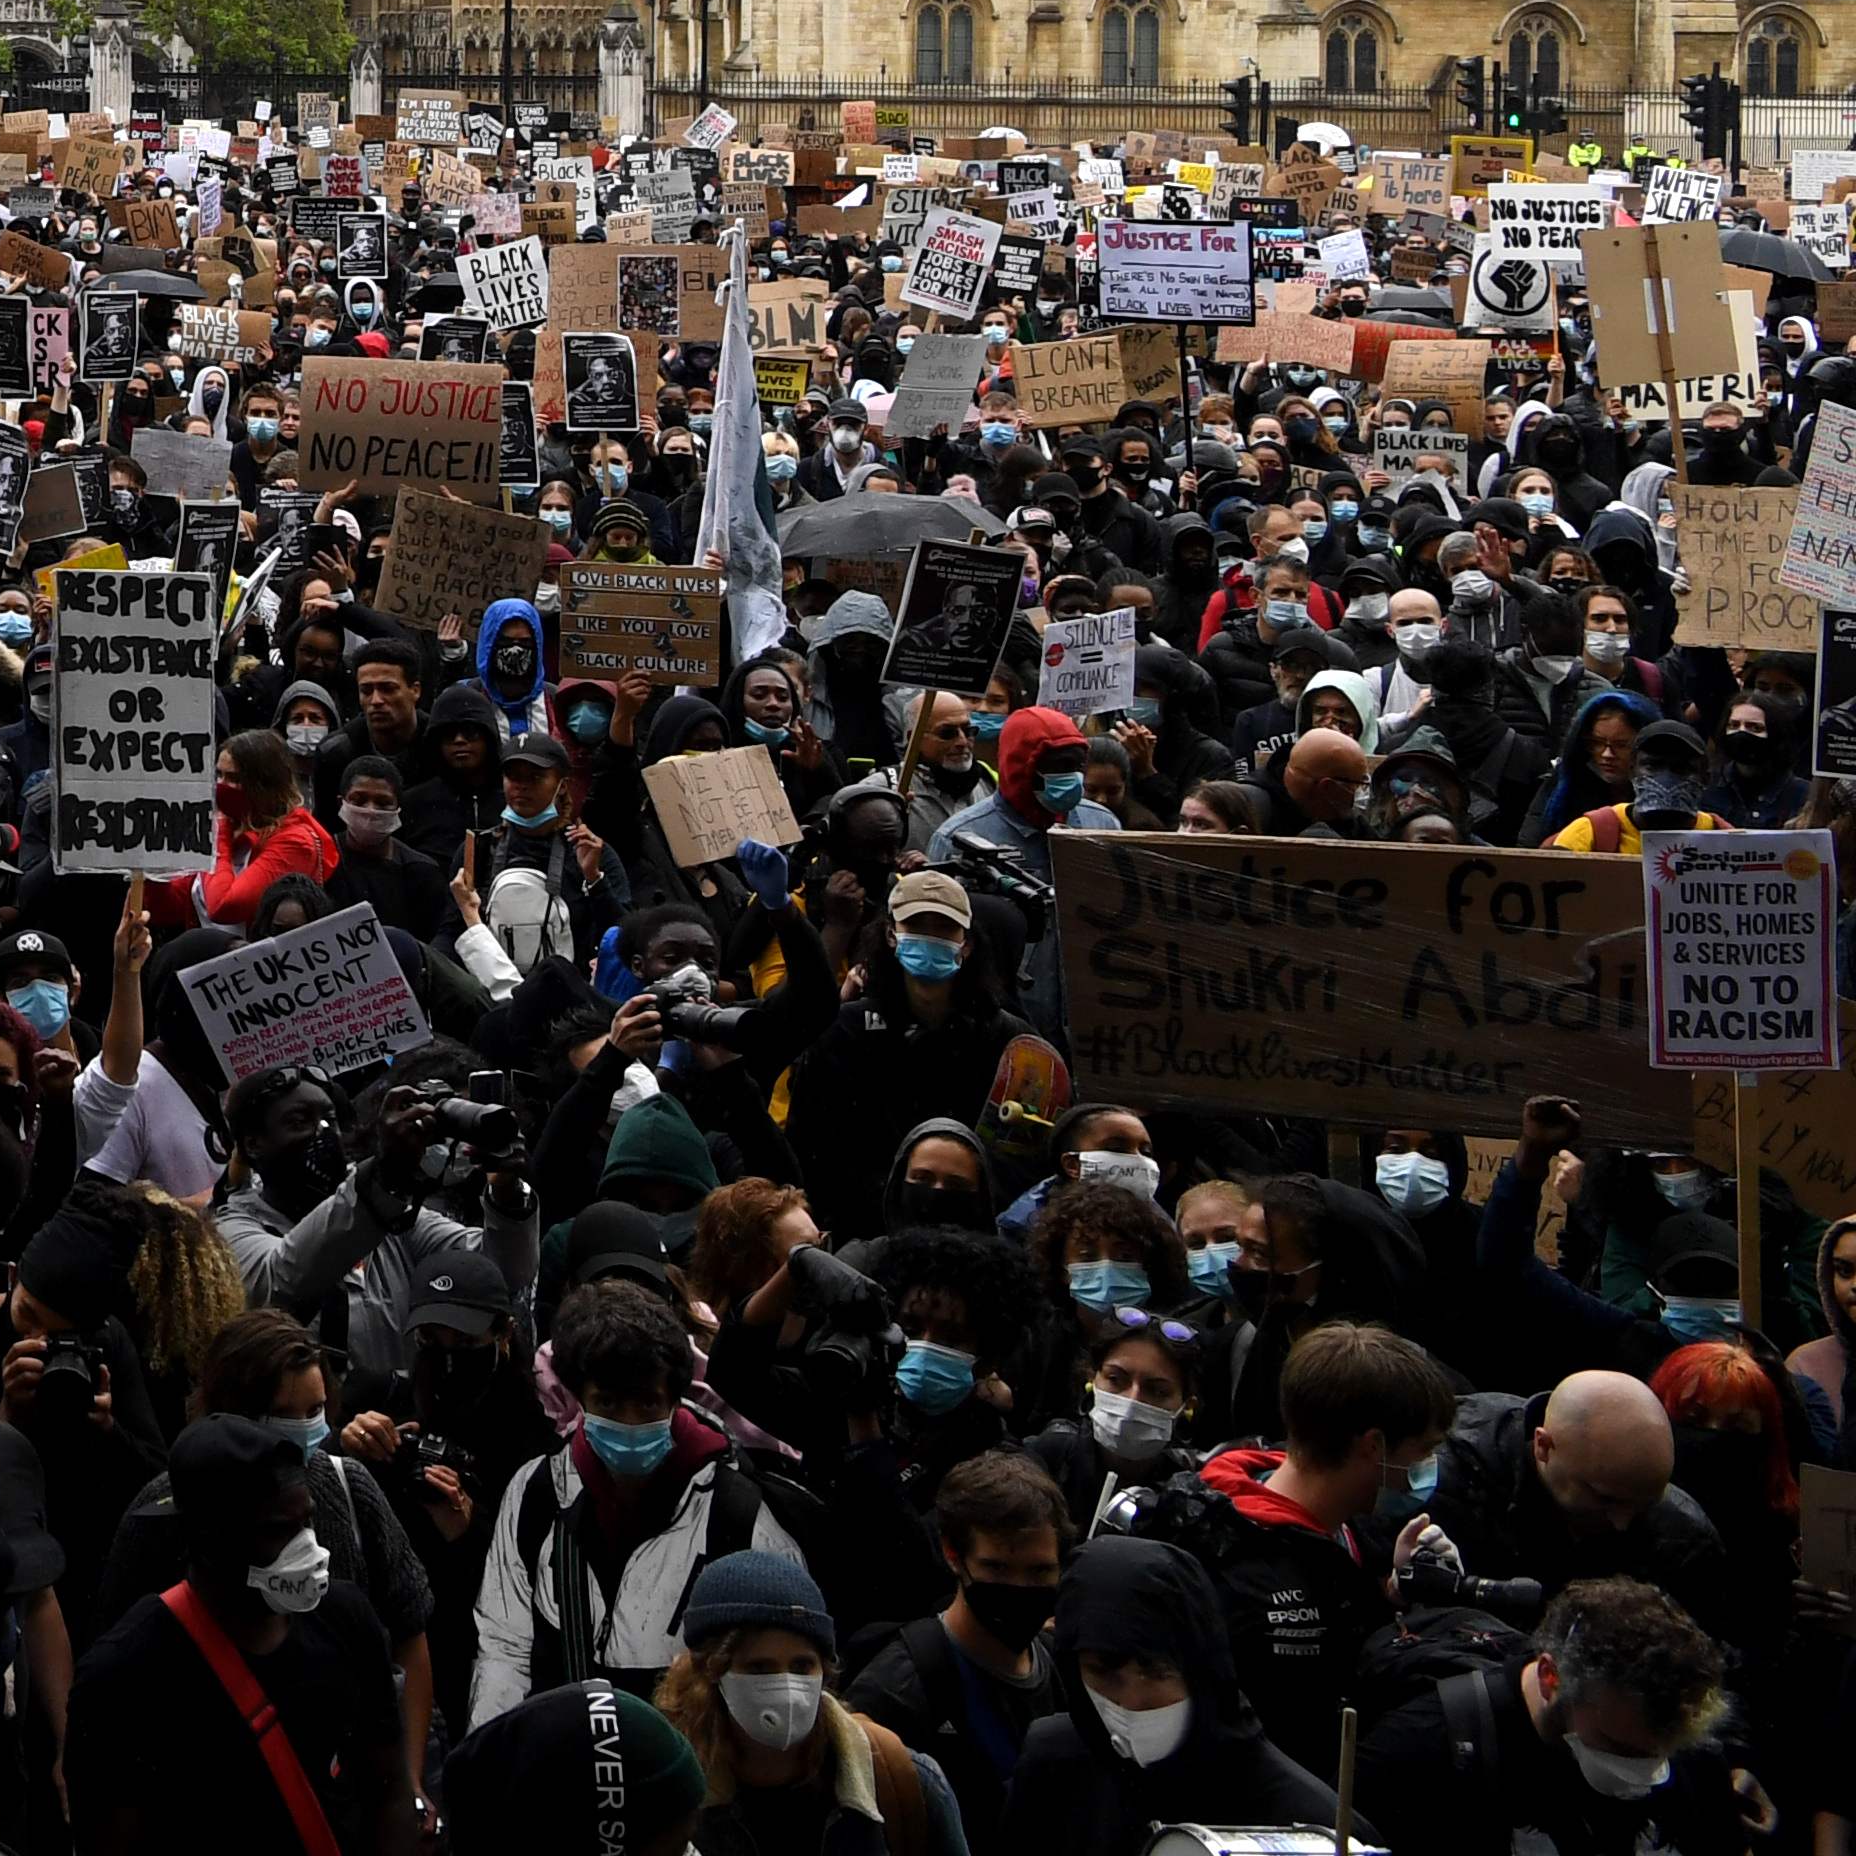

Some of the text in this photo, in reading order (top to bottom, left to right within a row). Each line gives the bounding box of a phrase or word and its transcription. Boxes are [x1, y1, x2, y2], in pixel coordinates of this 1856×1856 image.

[411, 110, 460, 121] OF BEING
[422, 99, 452, 111] TIRED
[397, 127, 459, 142] AGGRESSIVE
[448, 121, 460, 129] AS
[1490, 199, 1601, 224] NO JUSTICE
[1502, 227, 1532, 248] NO
[470, 243, 533, 284] BLACK
[478, 273, 539, 307] LIVES
[484, 297, 548, 330] MATTER
[1106, 297, 1250, 318] BLACK LIVES MATTER
[1019, 340, 1114, 376] I CAN'T
[315, 378, 500, 423] NO JUSTICE
[1032, 382, 1120, 412] BREATHE
[309, 432, 494, 484] NO PEACE!!
[570, 572, 714, 592] LOVE BLACK LIVES
[58, 571, 210, 627] RESPECT
[576, 617, 710, 638] LIKE YOU LOVE
[59, 635, 212, 679] EXISTENCE
[575, 654, 706, 673] BLACK CULTURE
[109, 687, 165, 723] OR
[63, 726, 210, 773] EXPECT
[60, 794, 212, 856] RESISTANCE
[1078, 845, 1387, 930] Justice
[1680, 883, 1797, 905] UNITE FOR
[1663, 913, 1815, 937] JOBS, HOMES
[192, 918, 379, 1010] THE UK IS NOT
[1673, 942, 1805, 965] & SERVICES
[227, 954, 370, 1035] INNOCENT
[1403, 945, 1635, 1030] Abdi
[1683, 975, 1798, 1004] NO TO
[312, 1016, 417, 1064] BLACK LIVES
[1668, 1010, 1813, 1040] RACISM
[335, 1041, 396, 1072] MATTER
[1271, 1589, 1304, 1604] IWC
[1267, 1608, 1319, 1623] EPSON
[587, 1691, 626, 1809] NEVER
